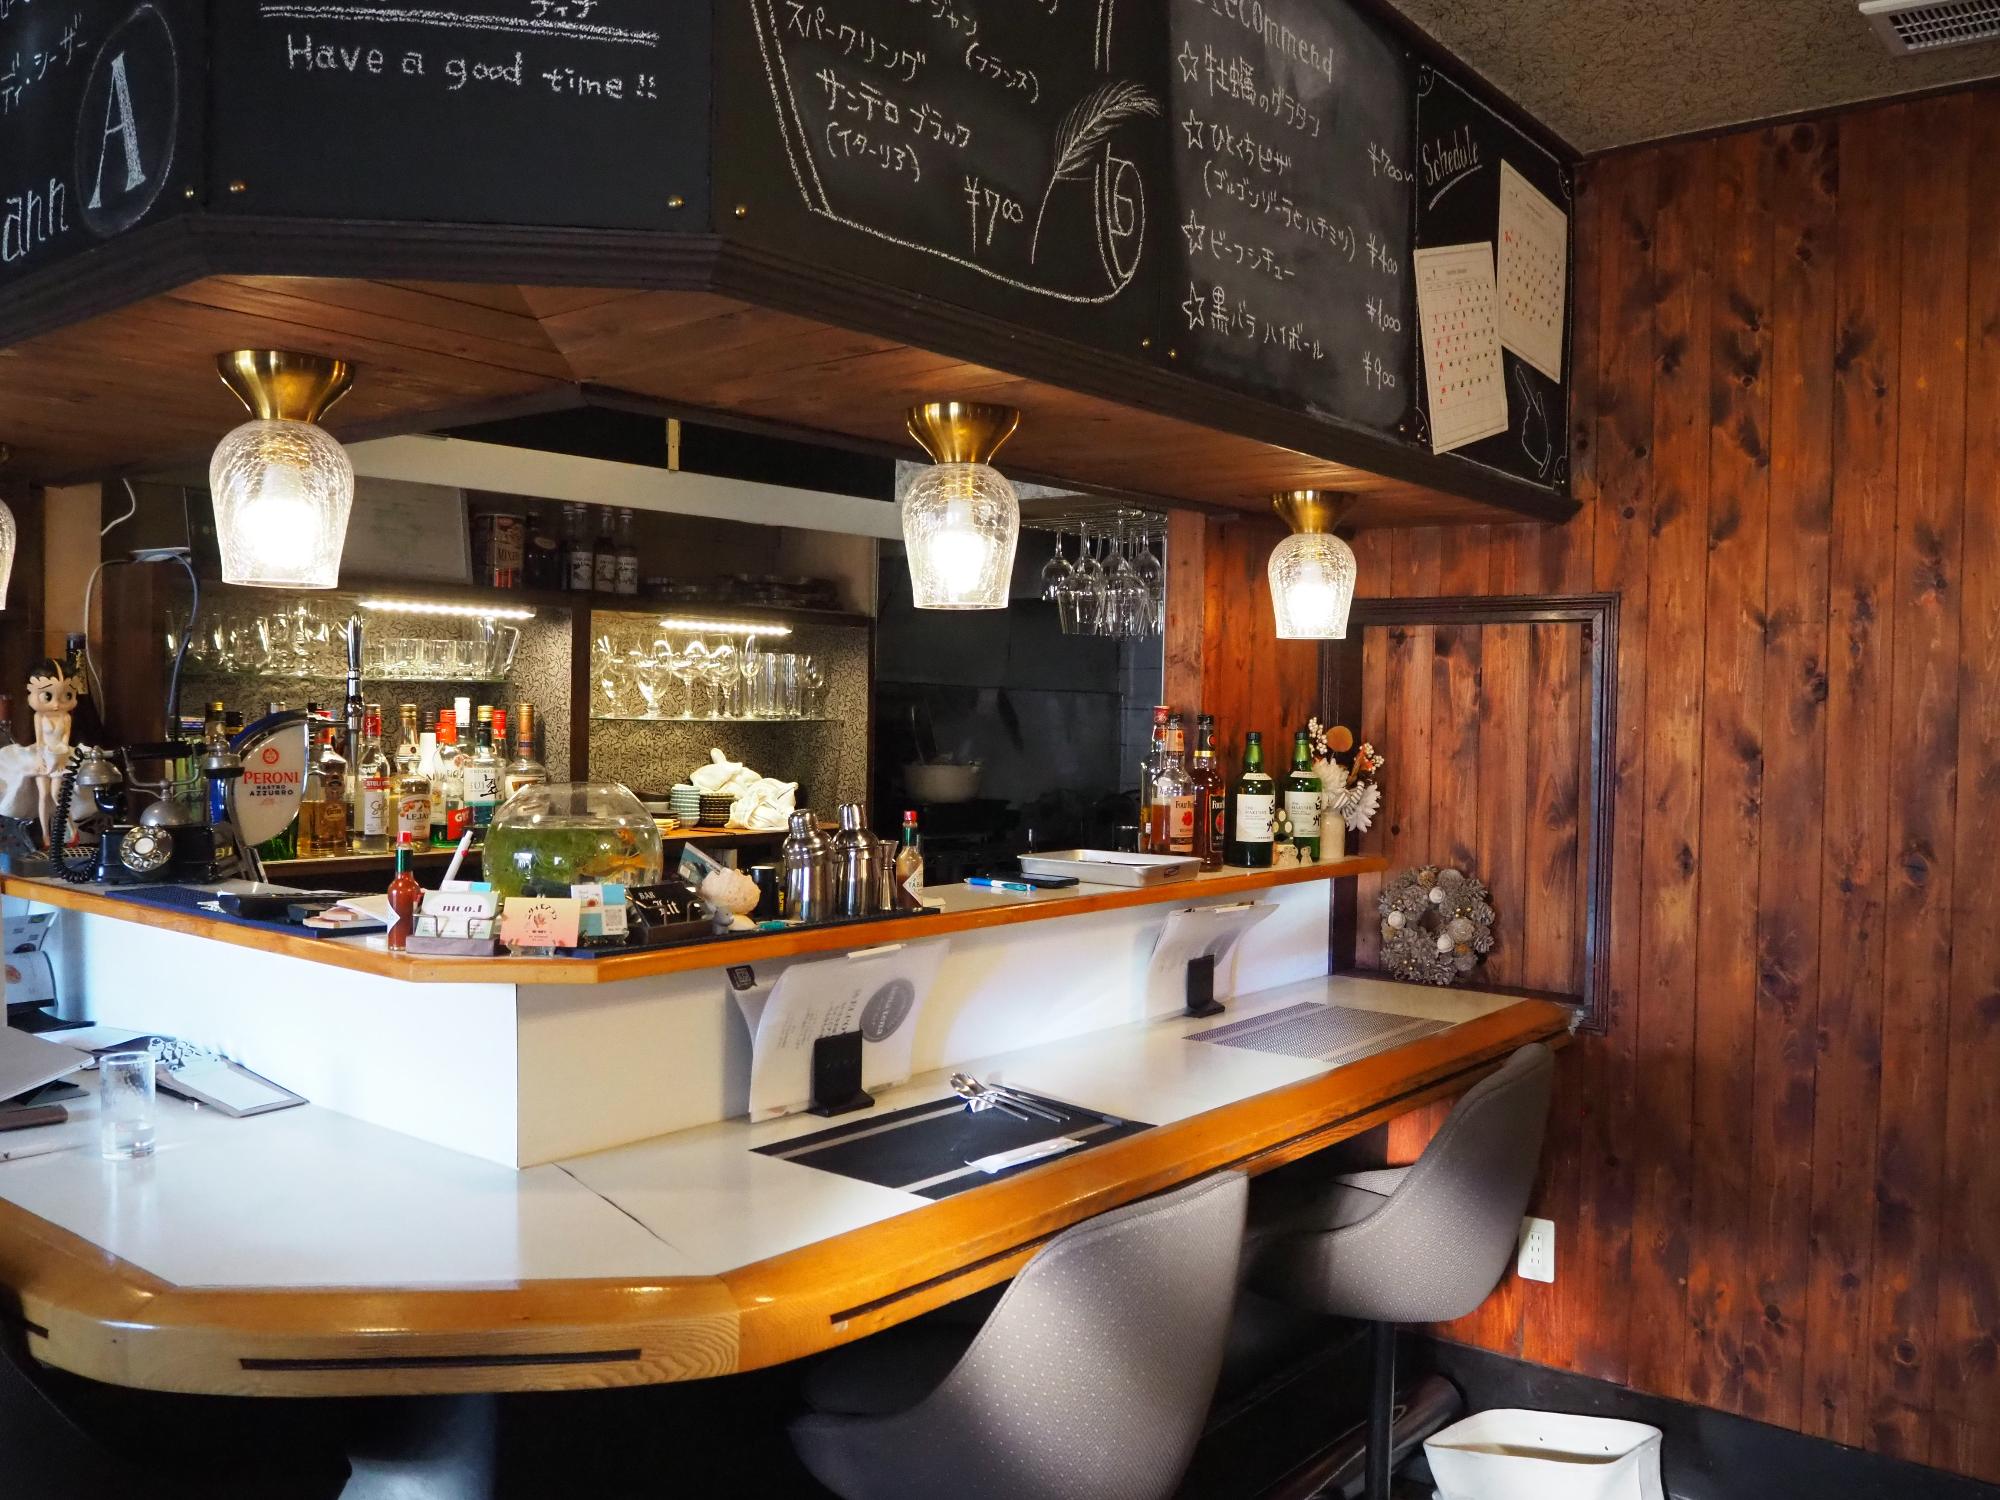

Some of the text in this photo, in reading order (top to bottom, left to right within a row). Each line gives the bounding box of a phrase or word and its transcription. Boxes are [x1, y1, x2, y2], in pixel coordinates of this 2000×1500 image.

[287, 33, 384, 74] Have
[402, 51, 424, 75] a
[445, 51, 522, 91] good
[542, 67, 624, 99] time
[786, 0, 926, 82] スパークリング
[1422, 124, 1480, 186] Schedule
[962, 175, 1024, 257] ¥700
[243, 770, 300, 785] PERONI
[250, 789, 294, 797] AZZURRO
